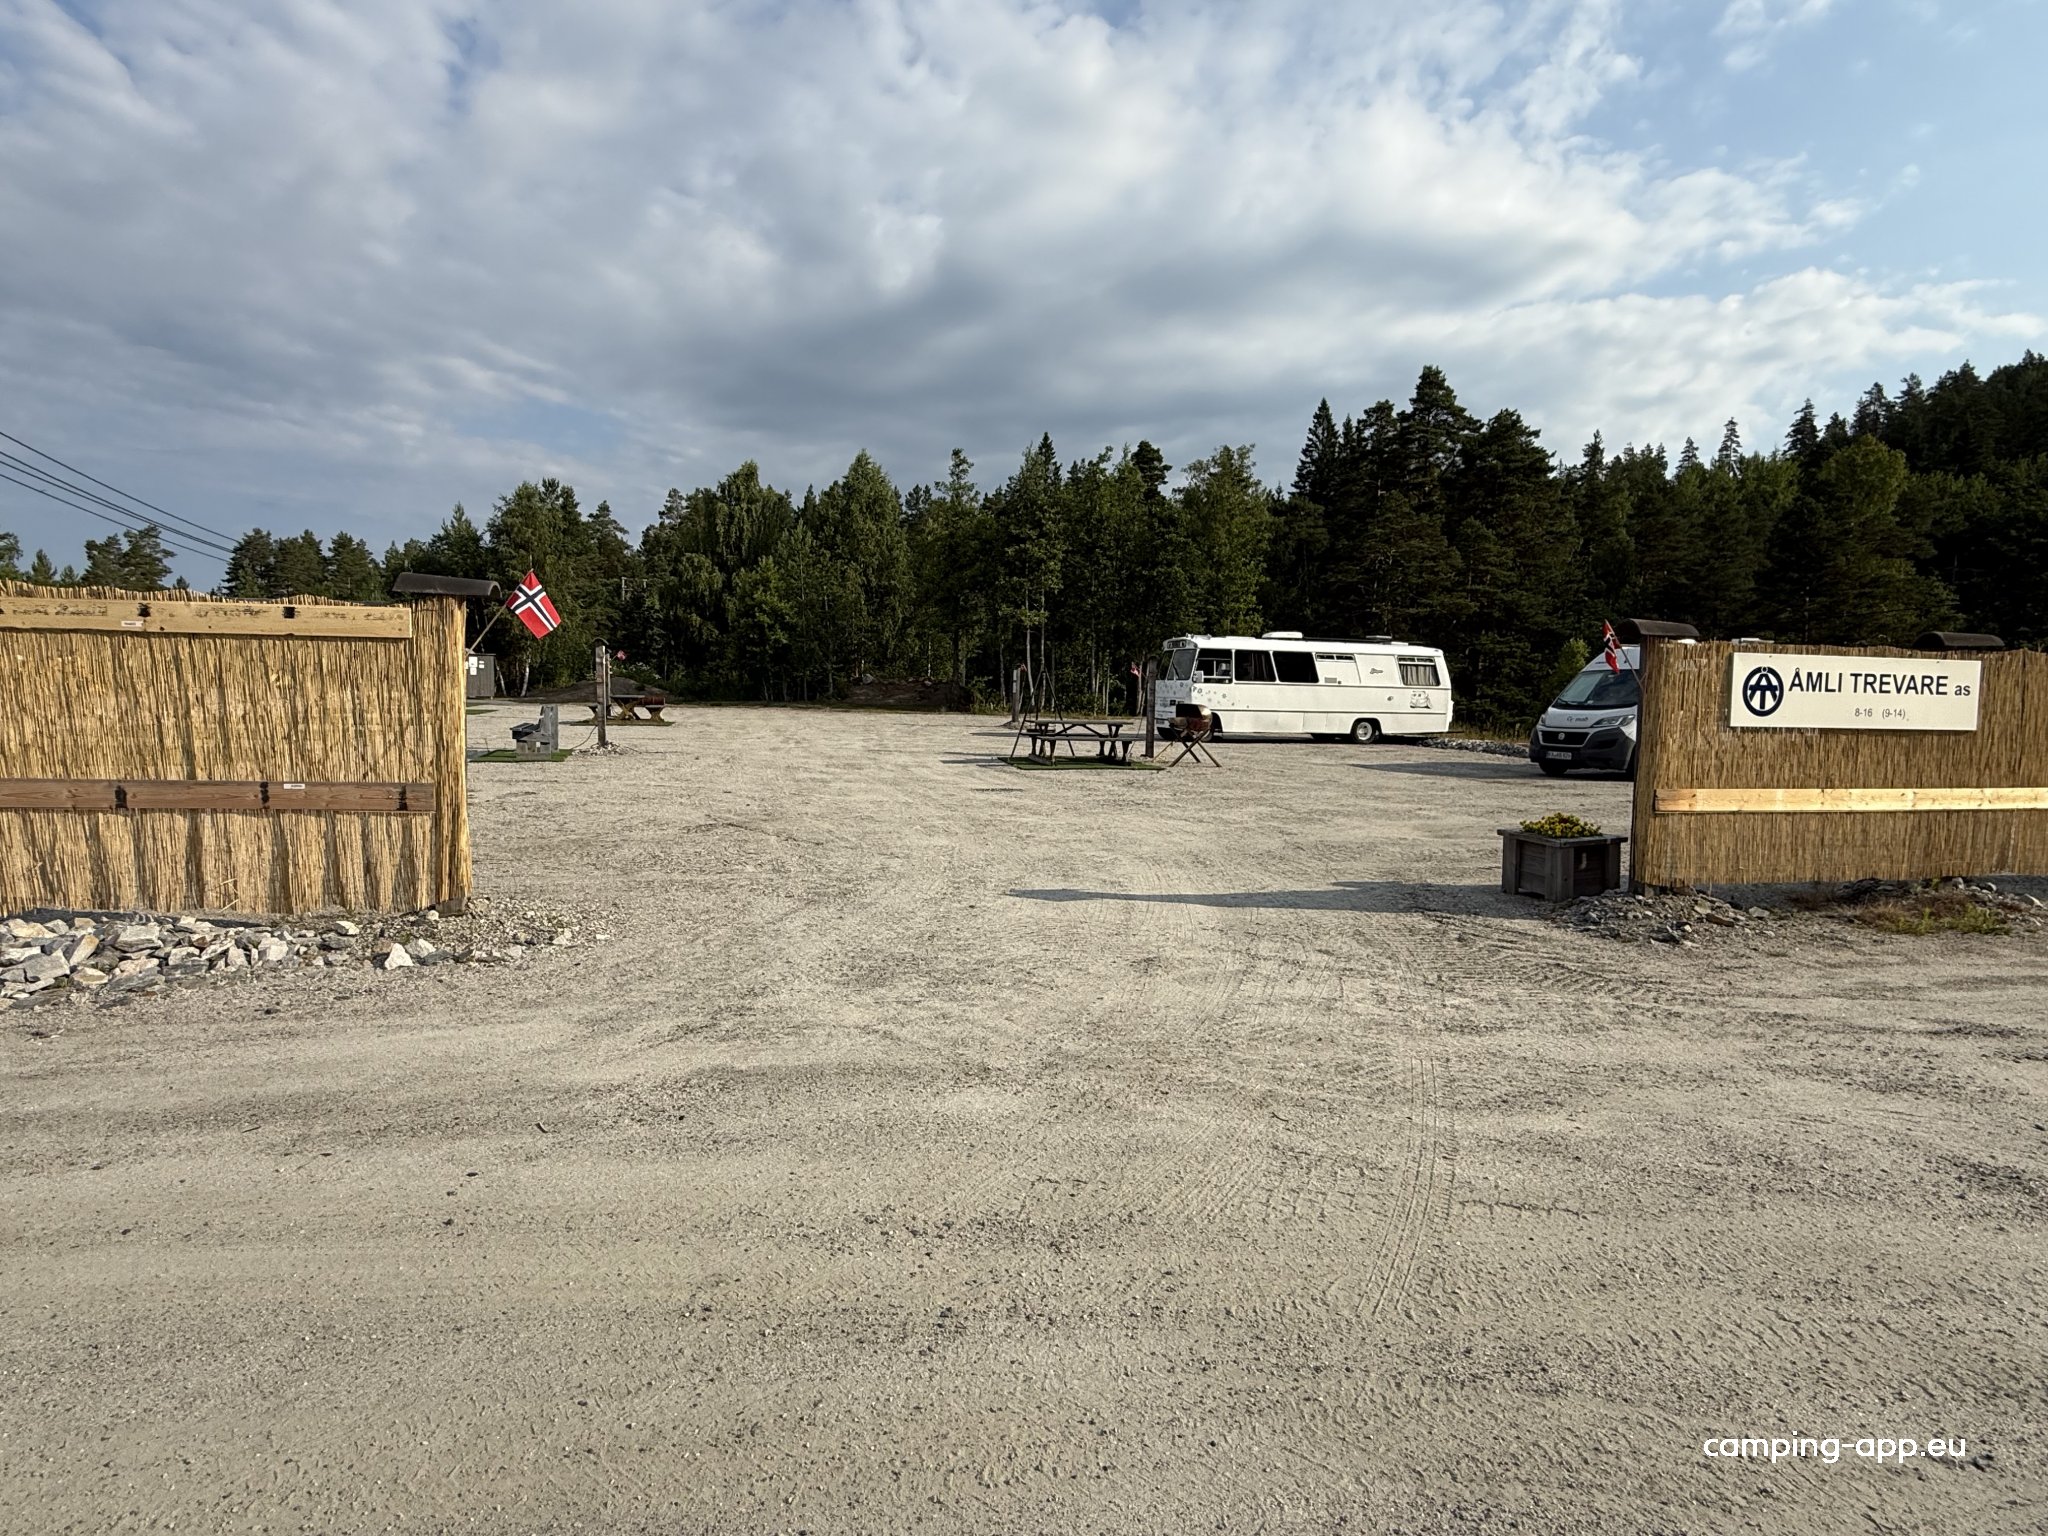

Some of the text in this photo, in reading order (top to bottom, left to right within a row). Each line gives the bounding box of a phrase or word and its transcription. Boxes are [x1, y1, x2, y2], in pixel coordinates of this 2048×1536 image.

[1788, 667, 1971, 697] ÅMLI TREVARE as
[1854, 707, 1906, 720] 8-16 (9-14)
